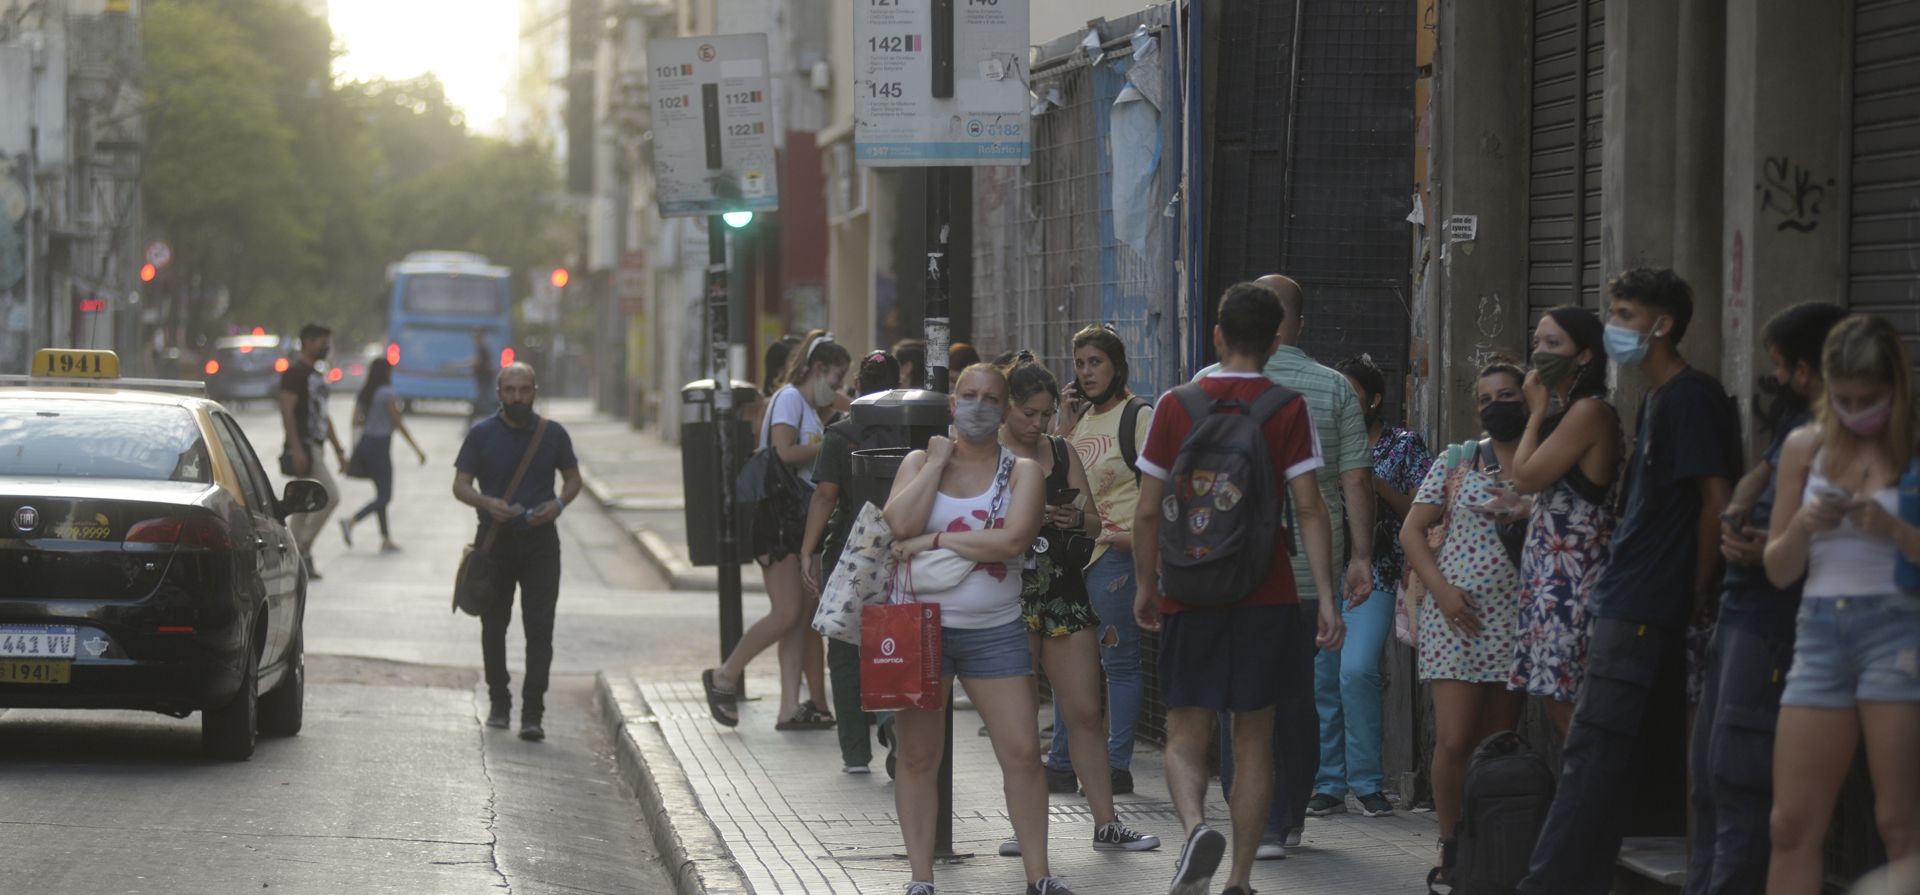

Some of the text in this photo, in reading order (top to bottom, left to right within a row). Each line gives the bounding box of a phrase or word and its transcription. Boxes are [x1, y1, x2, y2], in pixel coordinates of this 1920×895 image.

[868, 36, 902, 53] 142
[656, 65, 678, 78] 101
[869, 82, 903, 98] 145
[658, 96, 682, 109] 102
[725, 92, 749, 105] 112
[728, 123, 751, 136] 122
[48, 354, 102, 373] 1941
[20, 513, 34, 525] FIAT
[12, 663, 50, 680] 1941
